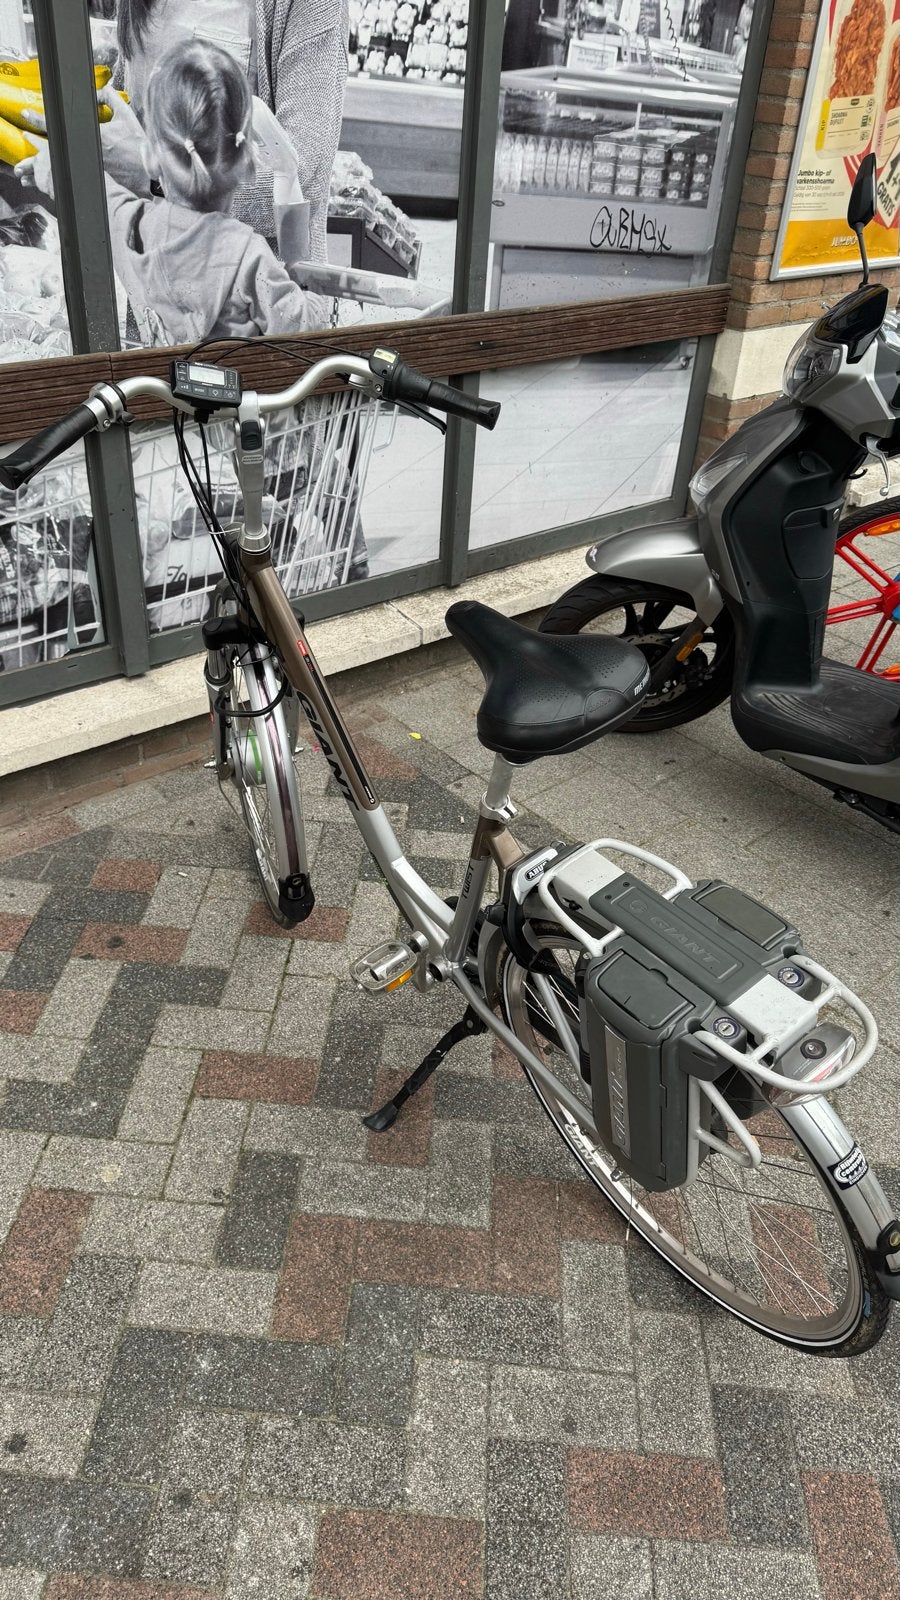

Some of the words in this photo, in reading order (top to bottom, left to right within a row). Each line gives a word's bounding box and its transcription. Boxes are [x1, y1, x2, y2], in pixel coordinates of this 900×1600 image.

[798, 169, 815, 177] Jumbo
[815, 169, 826, 177] kip-
[877, 181, 895, 217] GRATIS
[832, 236, 857, 247] JUMBO
[296, 690, 360, 811] GIANT
[462, 862, 475, 899] TWIST
[650, 916, 721, 964] GIANT
[564, 1123, 600, 1168] GIANT
